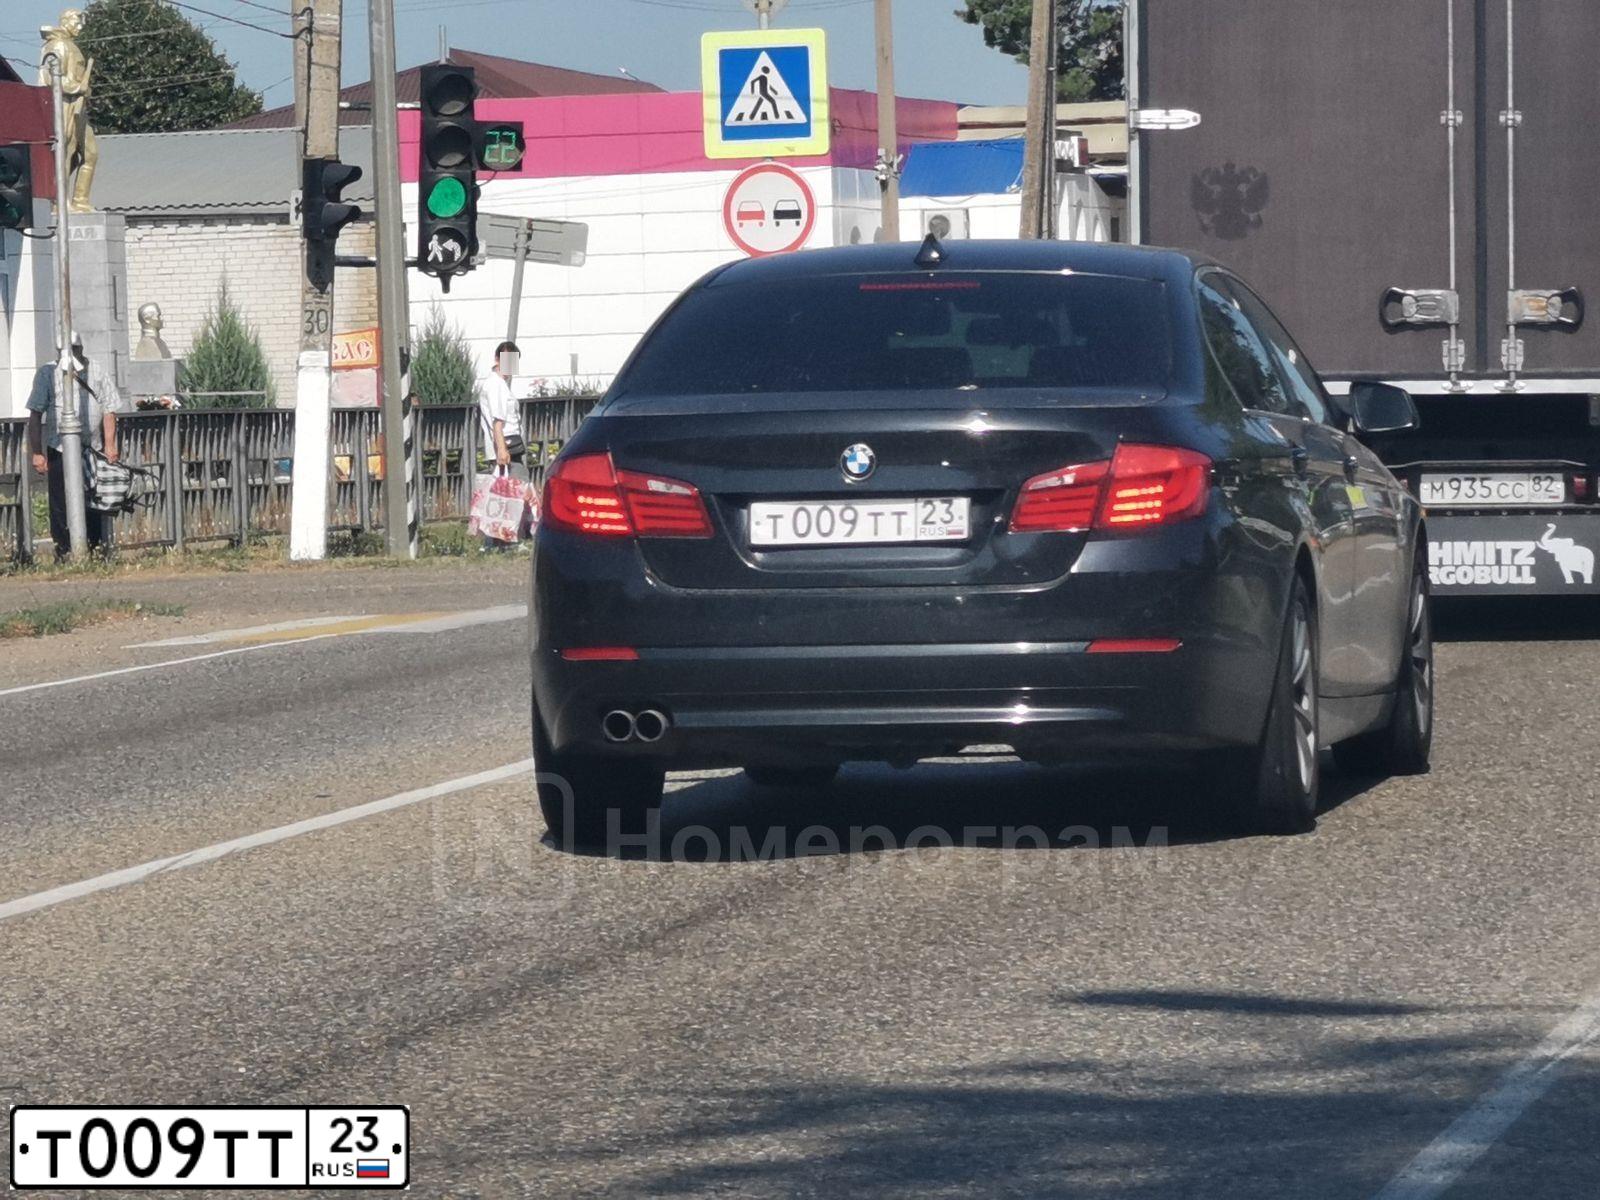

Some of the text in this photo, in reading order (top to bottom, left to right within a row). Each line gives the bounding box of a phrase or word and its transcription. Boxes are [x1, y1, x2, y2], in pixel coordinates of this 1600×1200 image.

[485, 131, 516, 163] 22
[304, 308, 329, 334] 30
[1532, 475, 1556, 493] 82
[766, 500, 954, 540] Т009ТТ 23
[919, 527, 946, 536] RUS
[1428, 541, 1535, 565] HMITZ
